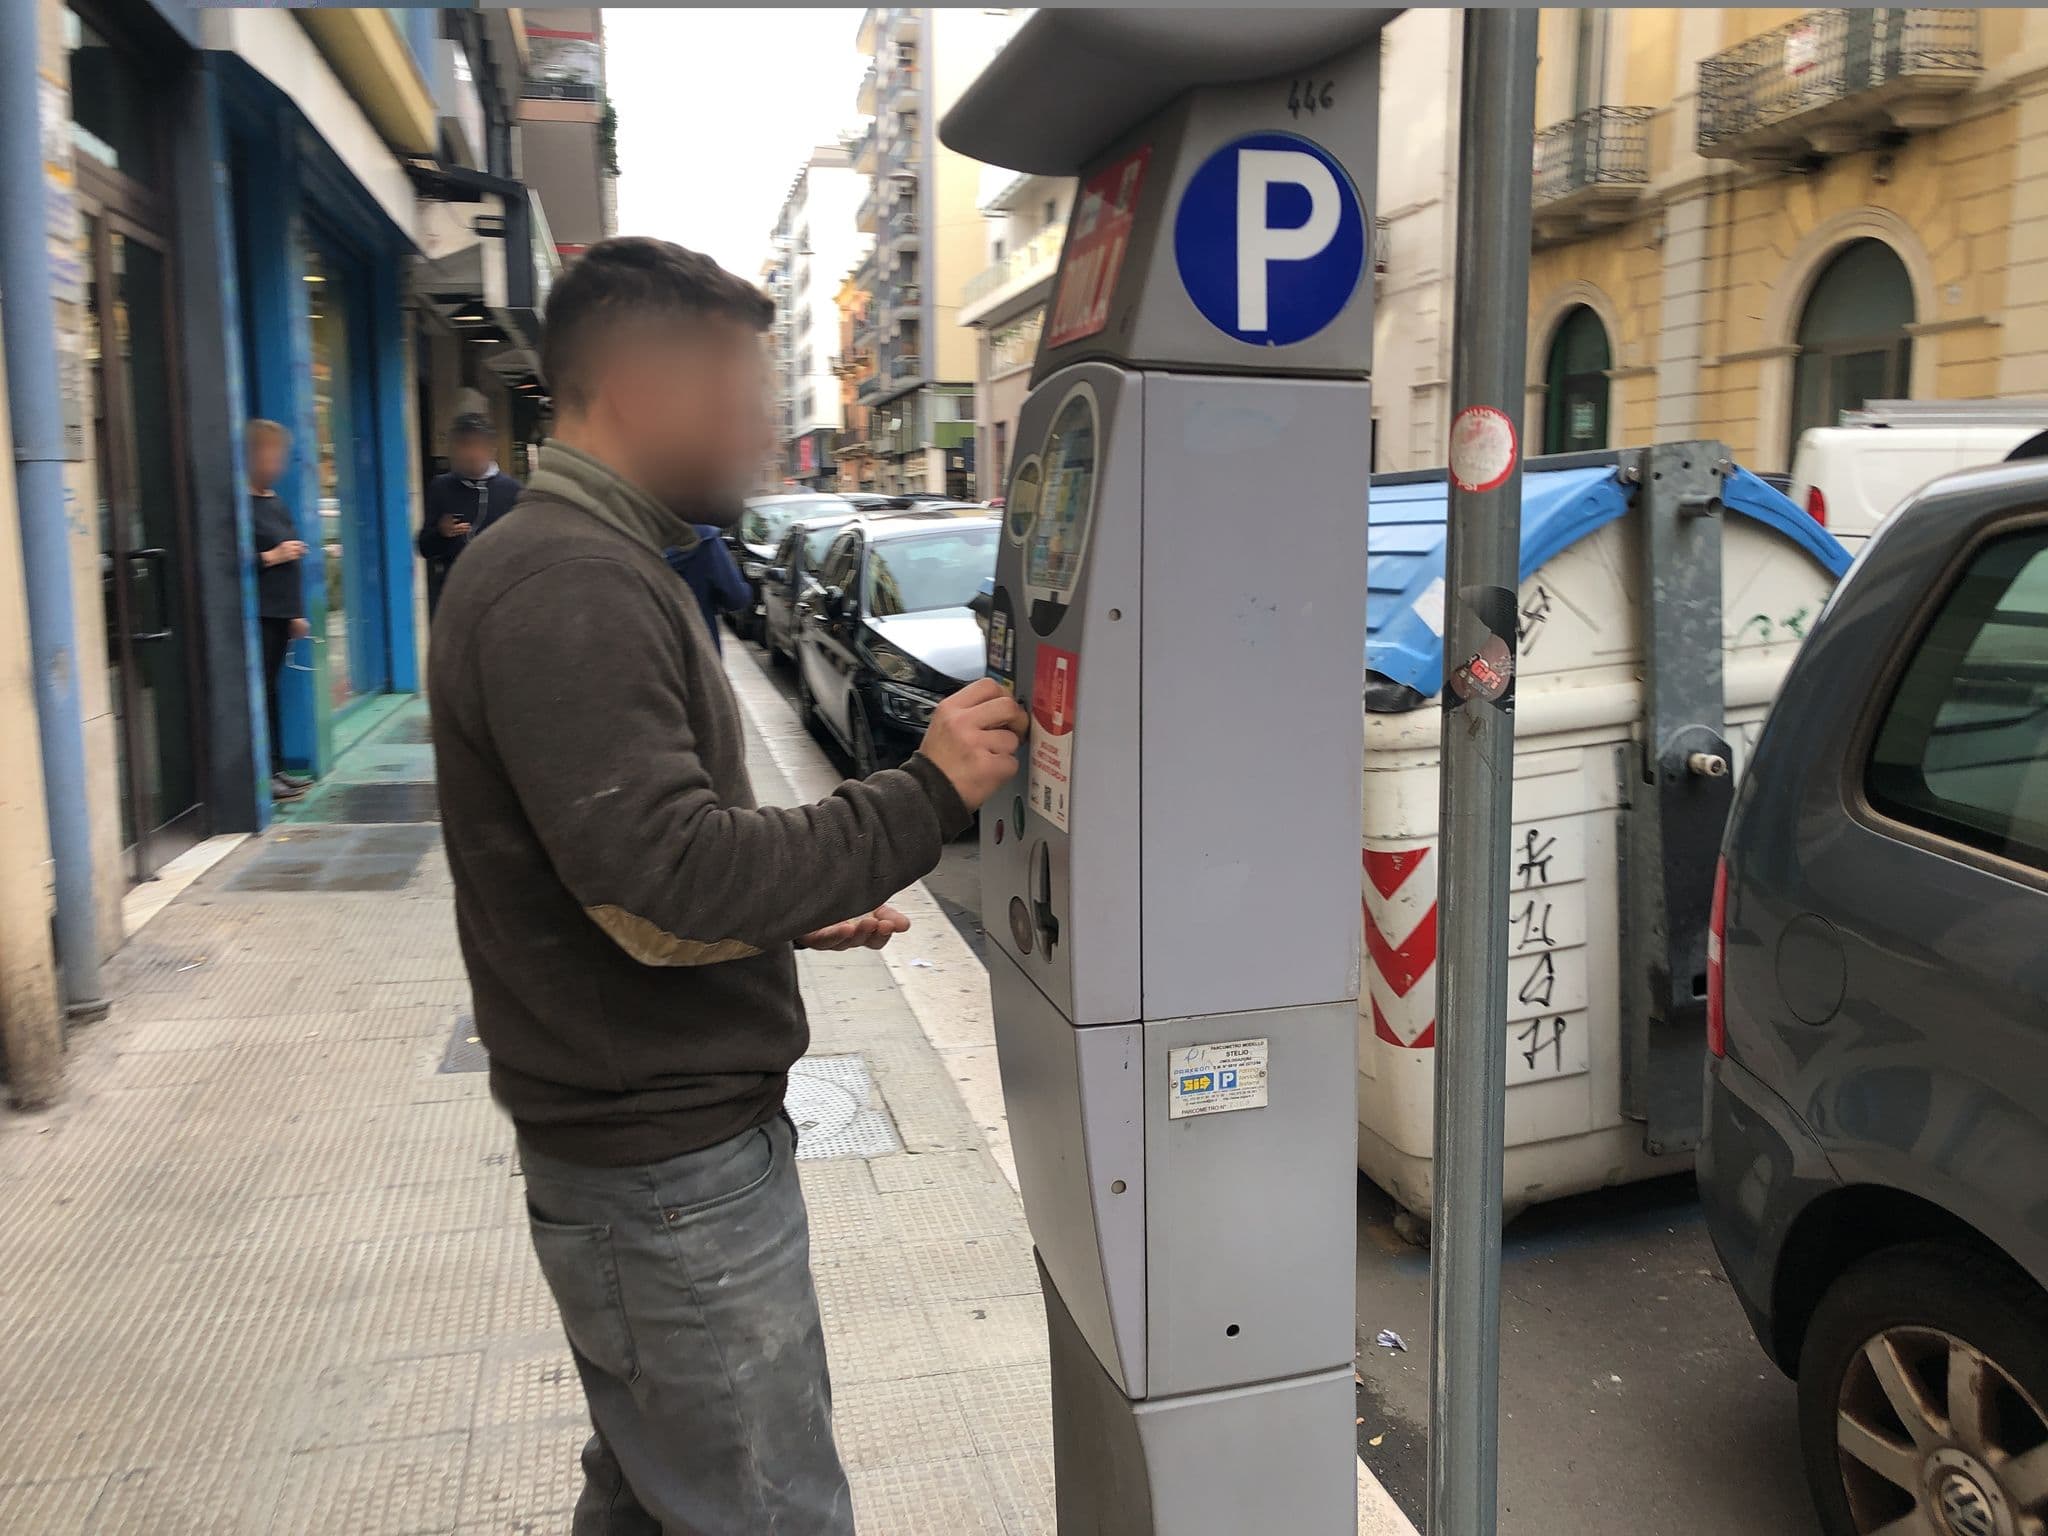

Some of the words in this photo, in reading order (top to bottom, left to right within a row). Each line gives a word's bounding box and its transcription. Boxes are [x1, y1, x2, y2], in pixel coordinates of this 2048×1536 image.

[1287, 81, 1335, 120] 446
[1237, 149, 1343, 333] P
[1226, 1049, 1249, 1057] STELIO
[1222, 1073, 1234, 1087] P
